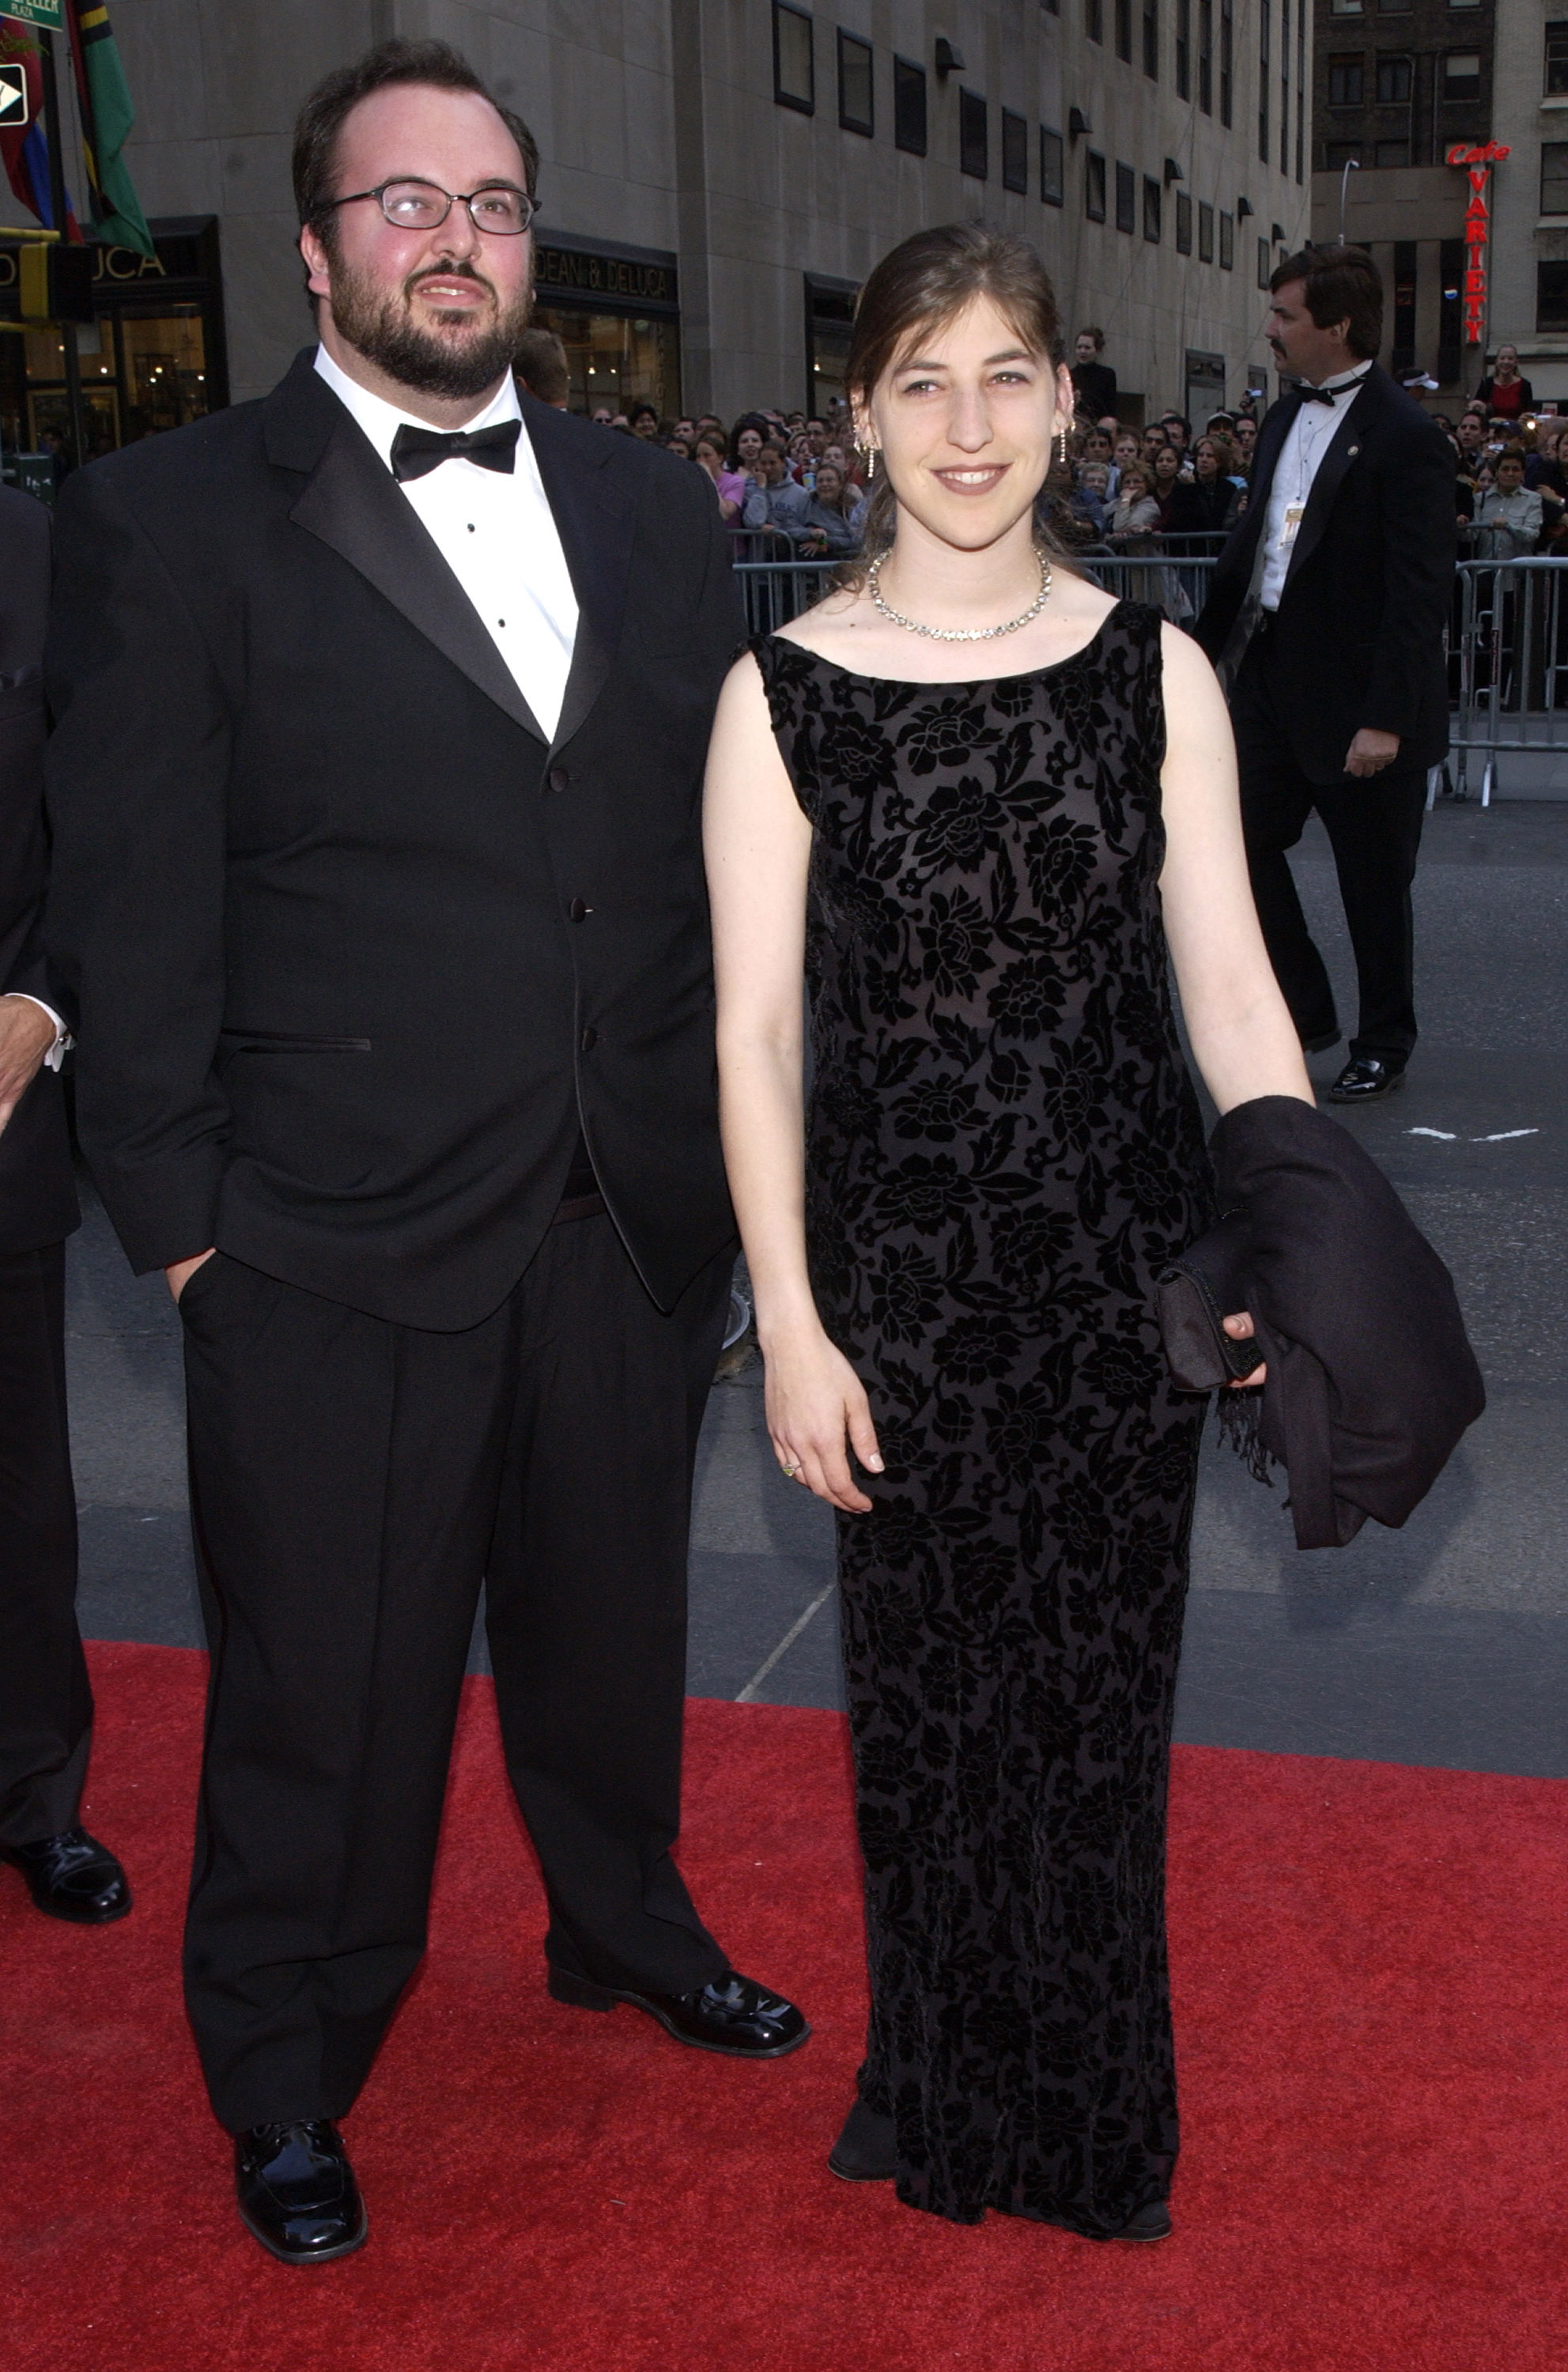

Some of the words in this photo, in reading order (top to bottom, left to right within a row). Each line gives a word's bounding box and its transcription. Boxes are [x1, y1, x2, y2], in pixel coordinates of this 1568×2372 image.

[11, 3, 34, 19] PLAZA
[1447, 140, 1511, 165] Cafe
[535, 250, 581, 287] DEAN
[590, 259, 601, 290] &
[607, 260, 667, 299] DELUCA
[1464, 170, 1491, 342] VARIETY
